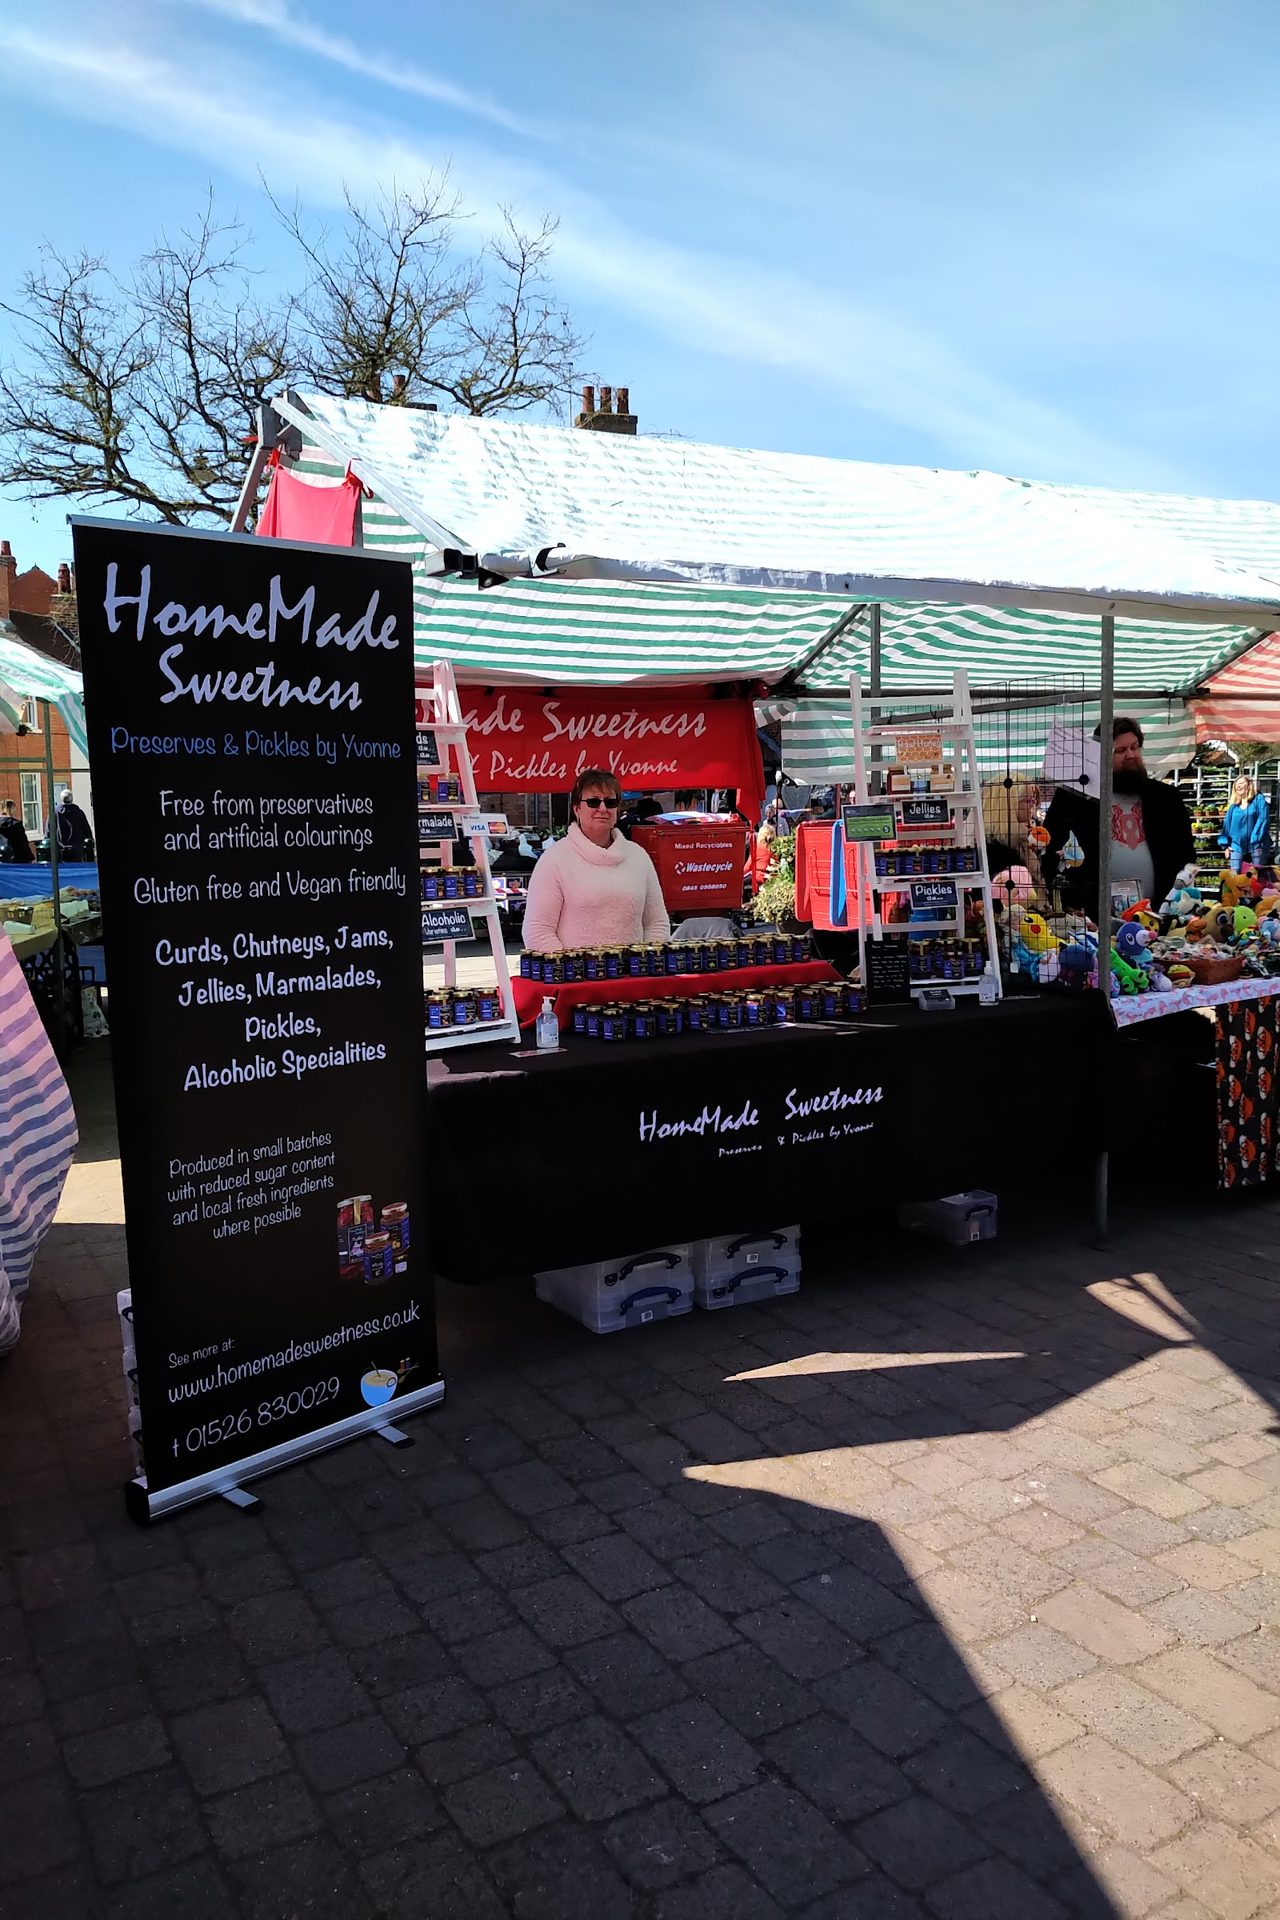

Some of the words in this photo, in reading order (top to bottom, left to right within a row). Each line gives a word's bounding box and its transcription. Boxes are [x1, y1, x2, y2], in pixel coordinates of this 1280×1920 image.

[103, 562, 400, 651] HomeMade
[158, 643, 362, 711] Sweetness
[542, 702, 707, 742] Sweetness
[110, 727, 216, 754] Preserves
[224, 733, 239, 755] &
[245, 730, 310, 758] Pickles
[316, 734, 337, 764] by
[342, 733, 401, 759] Yvonne
[489, 750, 566, 781] Pickles
[608, 750, 678, 776] Yvonne
[160, 790, 204, 817] Free
[212, 790, 254, 815] from
[260, 793, 373, 823] preservatives
[418, 815, 453, 827] rmalade
[909, 803, 941, 815] Jellies
[164, 823, 201, 851] and
[208, 822, 278, 849] artificial
[284, 822, 373, 851] colourings
[134, 877, 199, 904] Gluten
[207, 874, 242, 900] free
[249, 871, 280, 898] and
[286, 870, 341, 901] Vegan
[348, 867, 406, 896] friendly
[686, 861, 733, 873] Wastecycle
[915, 884, 952, 896] Pickles
[421, 911, 466, 928] Alcoholic
[155, 937, 229, 966] Curds,
[232, 932, 330, 959] Chutneys,
[334, 925, 394, 950] Jams,
[178, 978, 252, 1007] Jellies,
[255, 964, 382, 998] Marmalades,
[245, 1011, 322, 1042] Pickles,
[183, 1054, 276, 1091] Alcoholic
[281, 1041, 387, 1080] Specialities
[639, 1100, 759, 1142] HomeMade
[784, 1086, 883, 1120] Sweetness
[829, 1126, 841, 1139] by
[169, 1149, 234, 1178] Produced
[237, 1148, 249, 1165] in
[253, 1137, 284, 1161] small
[286, 1130, 332, 1152] batches
[167, 1184, 196, 1203] with
[199, 1172, 250, 1197] reduced
[254, 1164, 287, 1185] sugar
[291, 1152, 336, 1176] content
[172, 1207, 198, 1226] and
[202, 1197, 232, 1221] local
[236, 1187, 268, 1212] fresh
[270, 1174, 335, 1204] ingredients
[213, 1217, 250, 1240] where
[254, 1202, 302, 1235] possible
[168, 1300, 421, 1403] www.homemadesweetness.co.uk
[168, 1351, 190, 1369] See
[192, 1343, 219, 1362] more
[185, 1409, 252, 1453] 01526
[257, 1376, 340, 1427] 830029
